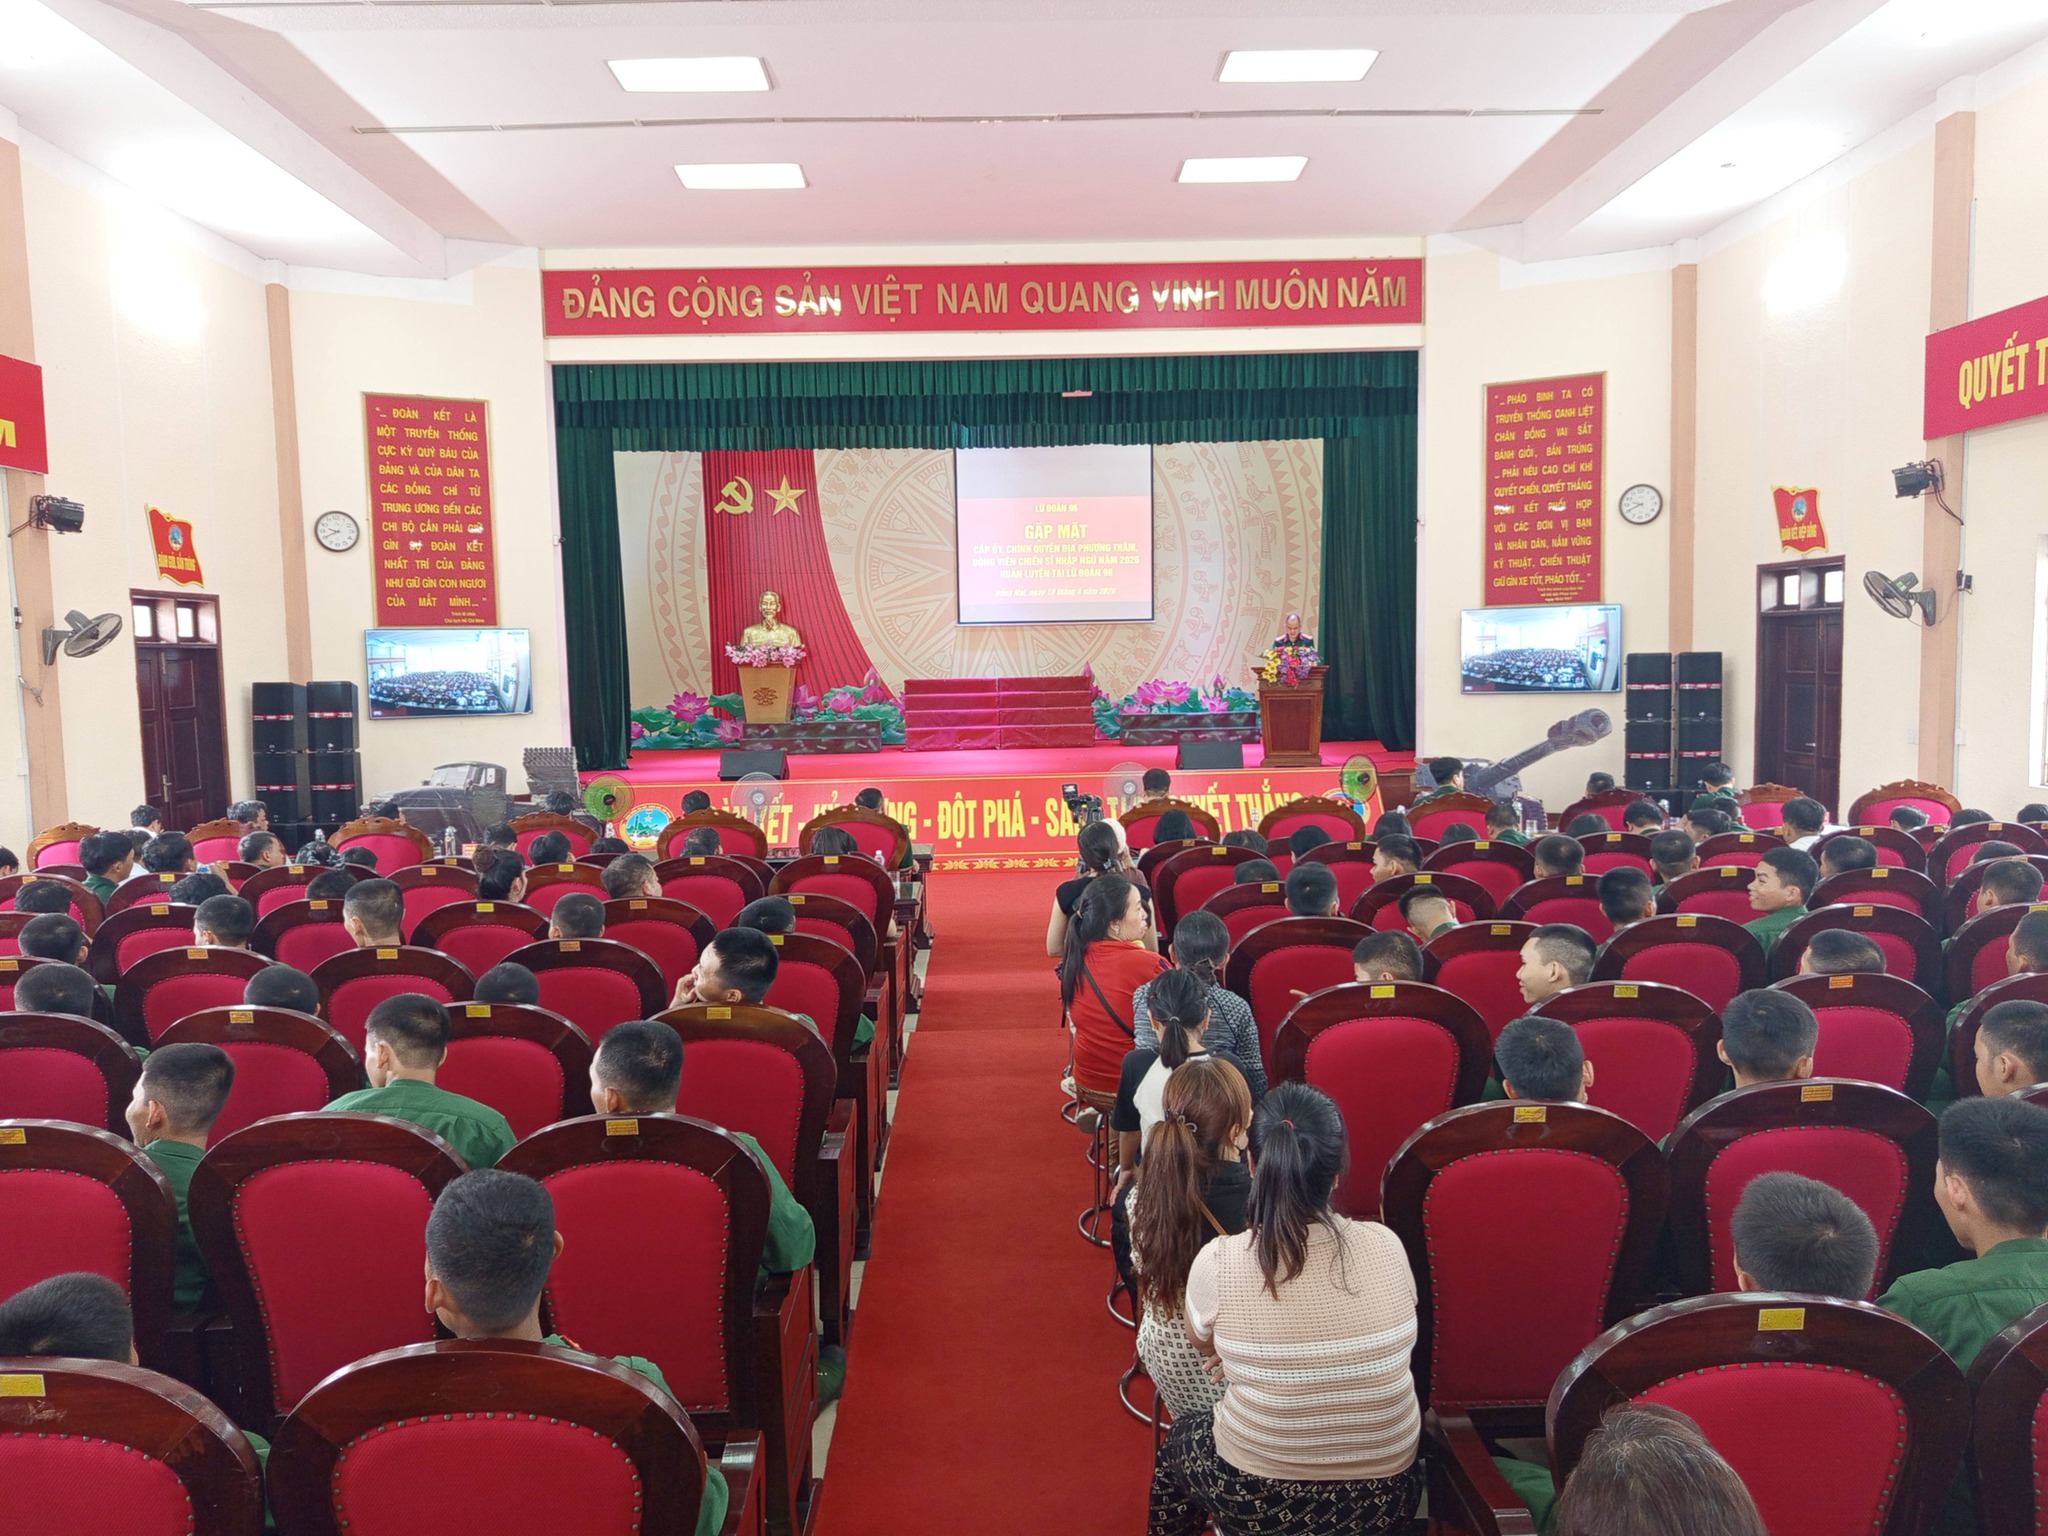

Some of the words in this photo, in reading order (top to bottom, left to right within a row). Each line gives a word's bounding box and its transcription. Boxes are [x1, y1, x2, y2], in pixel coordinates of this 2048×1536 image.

[563, 274, 655, 318] ĐẢNG
[668, 276, 763, 325] CỘNG
[775, 271, 842, 316] SẢN
[851, 274, 923, 322] VIỆT
[937, 282, 1008, 315] NAM
[1020, 280, 1139, 316] QUANG
[1150, 279, 1225, 313] VINH
[1235, 268, 1328, 310] MUÔN
[1337, 267, 1407, 309] NĂM
[1958, 331, 2030, 410] QUYẾT
[1536, 391, 1554, 402] BINH
[1562, 389, 1572, 399] TA
[1581, 385, 1594, 398] CÓ
[393, 407, 419, 419] ĐOÀN
[433, 407, 451, 421] KẾT
[465, 411, 477, 422] LÀ
[1495, 410, 1523, 424] TRUYỀN
[1526, 407, 1552, 421] THỐNG
[1555, 407, 1576, 419] OANH
[1578, 404, 1594, 418] LIỆT
[377, 424, 396, 438] MỘT
[404, 425, 440, 439] TRUYỀN
[448, 427, 478, 441] THỐNG
[1495, 430, 1515, 442] CHÂN
[1524, 426, 1546, 440] ĐỒNG
[1556, 427, 1568, 437] VAI
[1577, 421, 1594, 435] SẮT
[378, 445, 396, 457] CỰC
[400, 444, 413, 456] KỲ
[417, 446, 435, 457] QUÝ
[440, 447, 457, 459] BÁU
[461, 447, 479, 460] CỦA
[1494, 448, 1514, 460] ĐÁNH
[1546, 442, 1562, 456] BẮN
[1567, 442, 1593, 455] TRÚNG
[379, 461, 404, 475] ĐẢNG
[408, 463, 420, 475] VÀ
[425, 463, 442, 476] CỦA
[447, 465, 464, 477] DÂN
[469, 468, 480, 478] TA
[1523, 464, 1538, 476] NÊU
[1542, 464, 1558, 475] CAO
[1563, 461, 1575, 473] CHÍ
[1580, 460, 1593, 472] KHÍ
[380, 482, 398, 493] CÁC
[405, 481, 431, 494] ĐỒNG
[443, 484, 457, 496] CHÍ
[469, 484, 481, 497] TỪ
[1494, 482, 1517, 497] QUYẾT
[1542, 479, 1565, 493] QUYẾT
[1567, 477, 1592, 491] THẮNG
[381, 502, 411, 513] TRUNG
[414, 502, 440, 514] ƯƠNG
[443, 501, 461, 514] ĐẾN
[464, 503, 482, 515] CÁC
[1524, 500, 1539, 513] KẾT
[1576, 499, 1592, 511] HỢP
[382, 521, 398, 532] CHI
[402, 520, 415, 534] BỘ
[420, 519, 438, 532] CẦN
[443, 520, 463, 533] PHẢI
[1024, 521, 1053, 542] GẶP
[1057, 521, 1088, 541] MẶT
[1494, 520, 1506, 533] VỚI
[1513, 520, 1529, 532] CÁC
[1536, 519, 1553, 530] ĐƠN
[1561, 519, 1568, 531] VỊ
[1576, 518, 1592, 530] BẠN
[383, 539, 399, 550] GÌN
[431, 540, 456, 551] ĐOÀN
[467, 539, 484, 552] KẾT
[1006, 543, 1032, 554] CHÍNH
[1033, 542, 1060, 554] QUYỀN
[1078, 543, 1111, 552] PHƯƠNG
[1494, 539, 1503, 551] VÀ
[1507, 538, 1527, 550] NHÂN
[1552, 533, 1568, 547] NẮM
[1571, 535, 1592, 546] VỮNG
[384, 556, 408, 569] NHẤT
[415, 558, 429, 570] TRÍ
[436, 557, 454, 570] CỦA
[461, 557, 485, 570] ĐẢNG
[1540, 553, 1562, 566] CHIẾN
[1567, 553, 1592, 566] THUẬT
[386, 578, 404, 588] NHƯ
[406, 576, 421, 588] GIỮ
[422, 576, 437, 588] GÌN
[439, 578, 458, 588] CON
[1506, 575, 1517, 586] GÌN
[1519, 576, 1528, 585] XE
[1545, 572, 1564, 584] PHÁO
[386, 594, 406, 607] CỦA
[419, 593, 437, 607] MẮT
[937, 792, 977, 848] ĐỘT
[983, 790, 1025, 838] PHÁ
